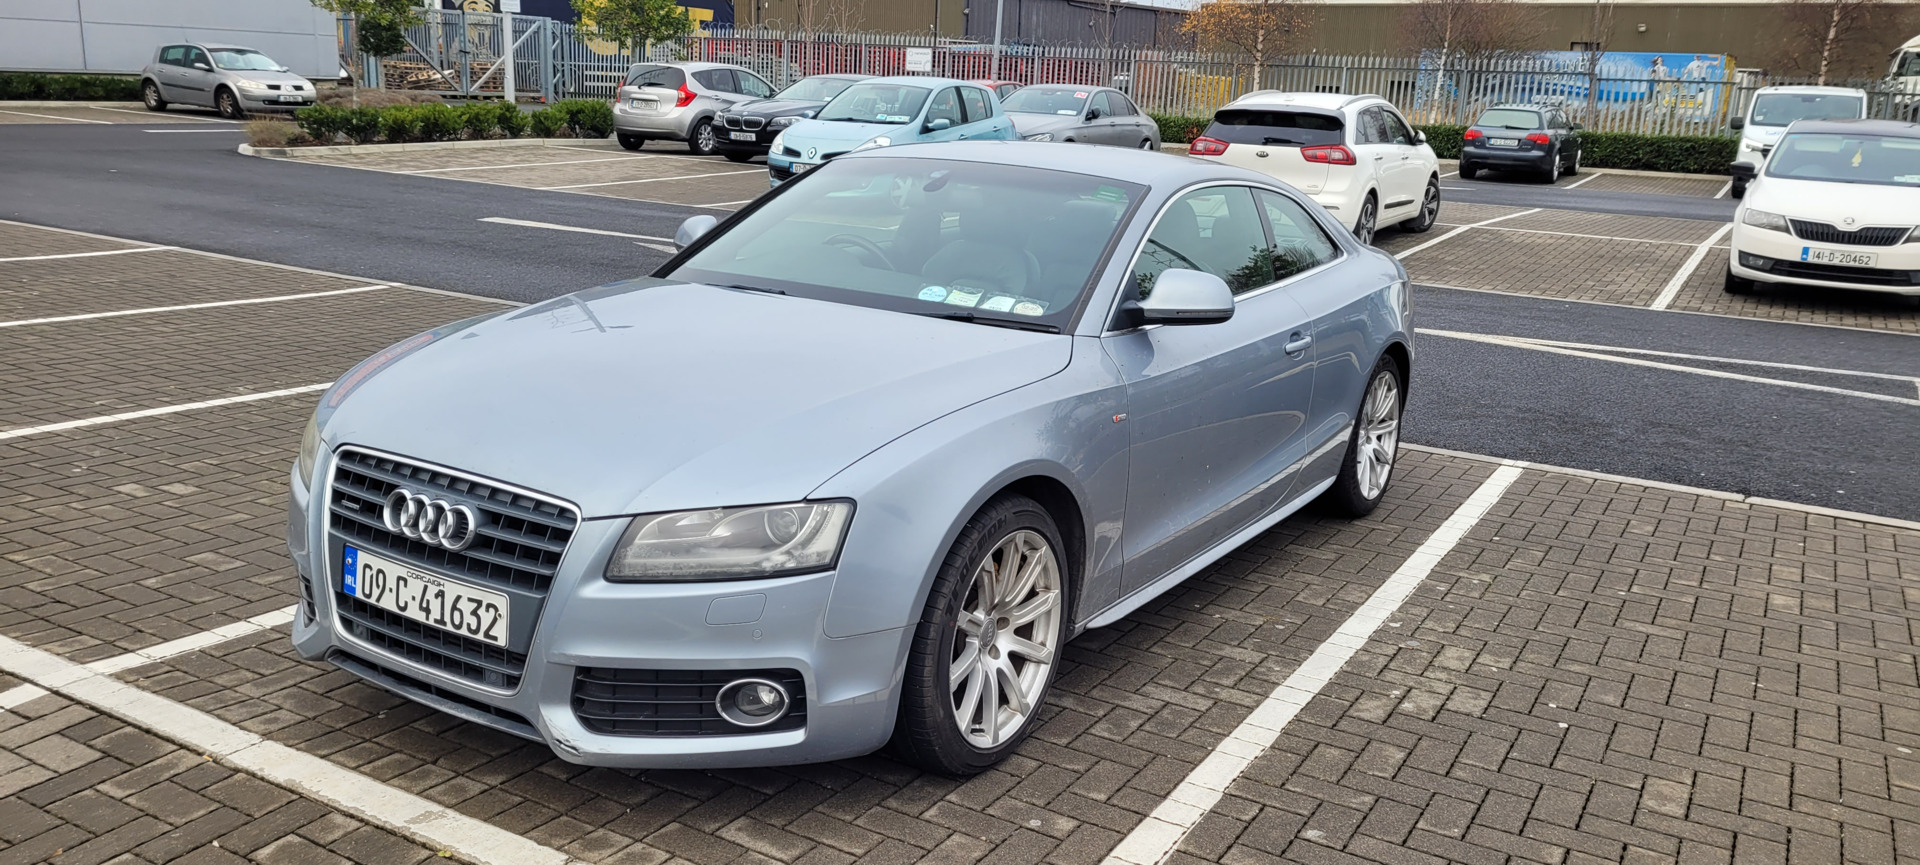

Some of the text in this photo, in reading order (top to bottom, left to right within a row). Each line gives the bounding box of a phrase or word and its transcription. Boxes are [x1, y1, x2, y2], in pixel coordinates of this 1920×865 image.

[1812, 250, 1871, 266] 141-D-20462
[406, 570, 446, 589] CORCAIGH
[344, 562, 500, 643] IRL 09-C-41632
